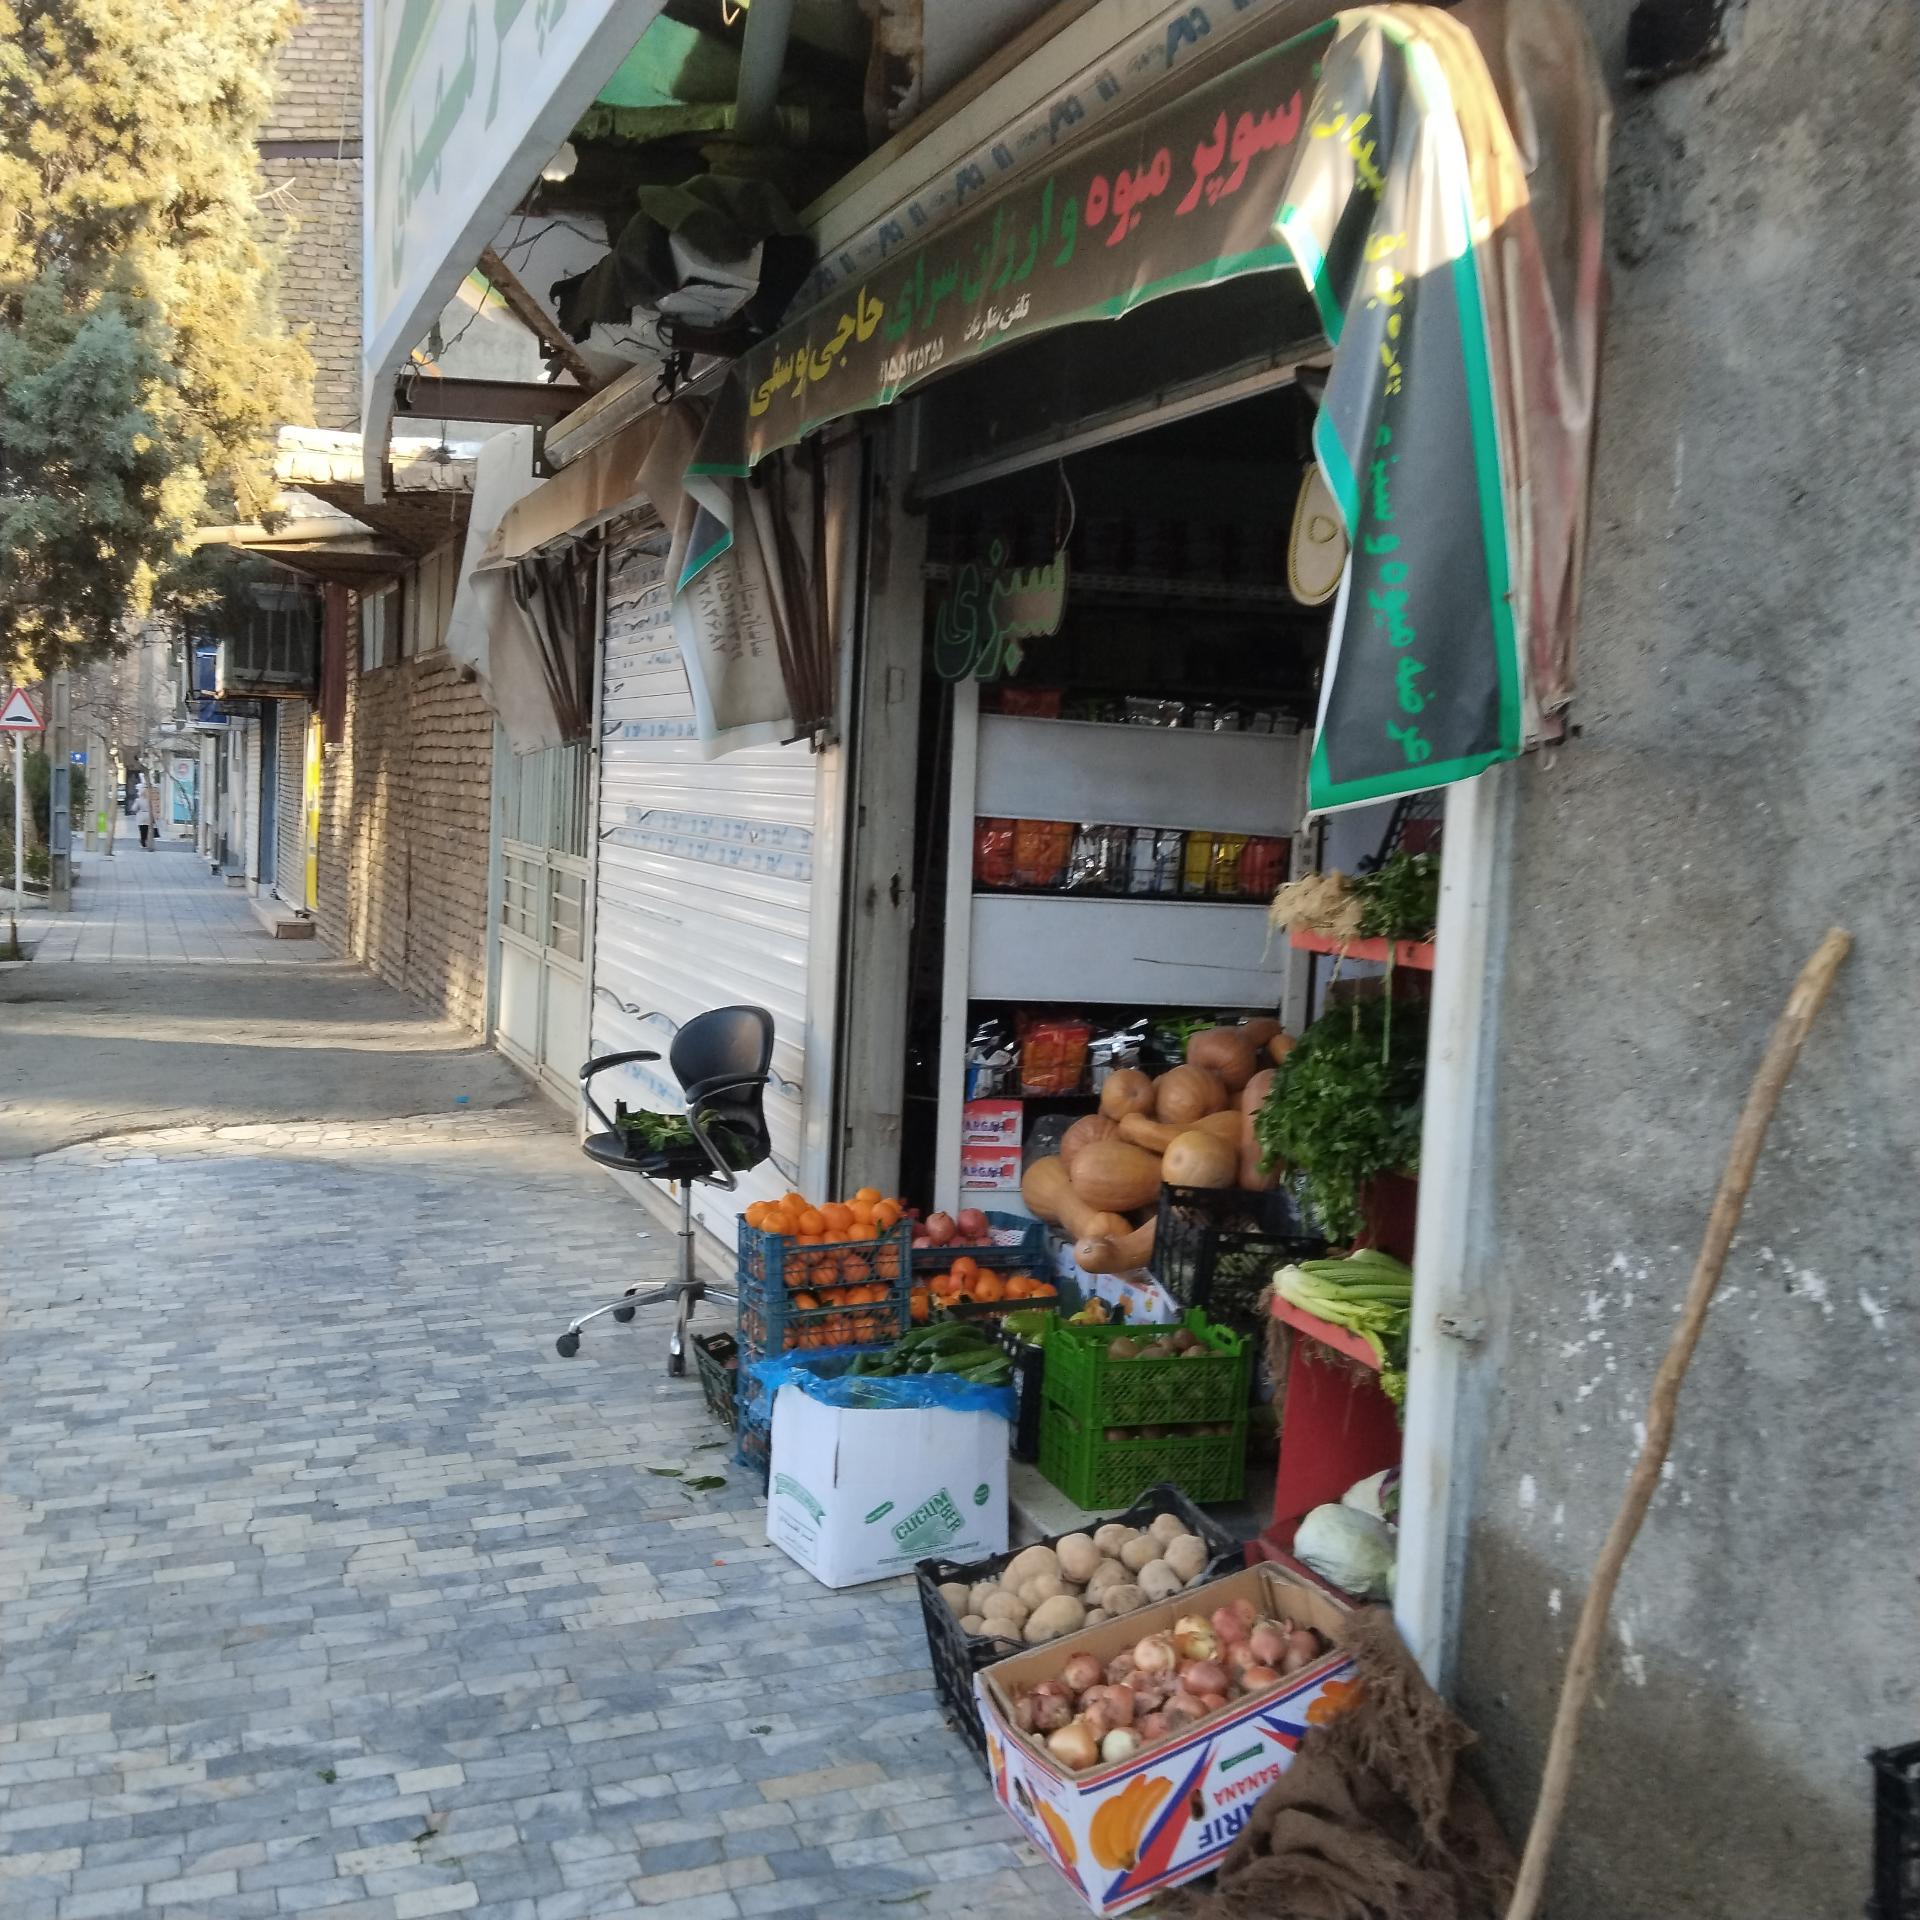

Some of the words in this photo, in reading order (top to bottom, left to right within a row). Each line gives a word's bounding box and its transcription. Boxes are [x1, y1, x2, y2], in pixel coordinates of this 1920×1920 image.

[1084, 147, 1171, 247] میوه
[1175, 88, 1302, 216] سوپر
[961, 175, 1054, 305] ارزان
[1053, 197, 1078, 268] و
[808, 284, 884, 381] حاجی
[883, 252, 960, 343] سرای
[999, 292, 1032, 330] تلفن
[1363, 533, 1400, 556] و
[934, 539, 1069, 682] سبزی
[1366, 561, 1417, 648] میوه
[1385, 656, 1436, 764] عرضه
[1213, 1763, 1280, 1806] BANANA
